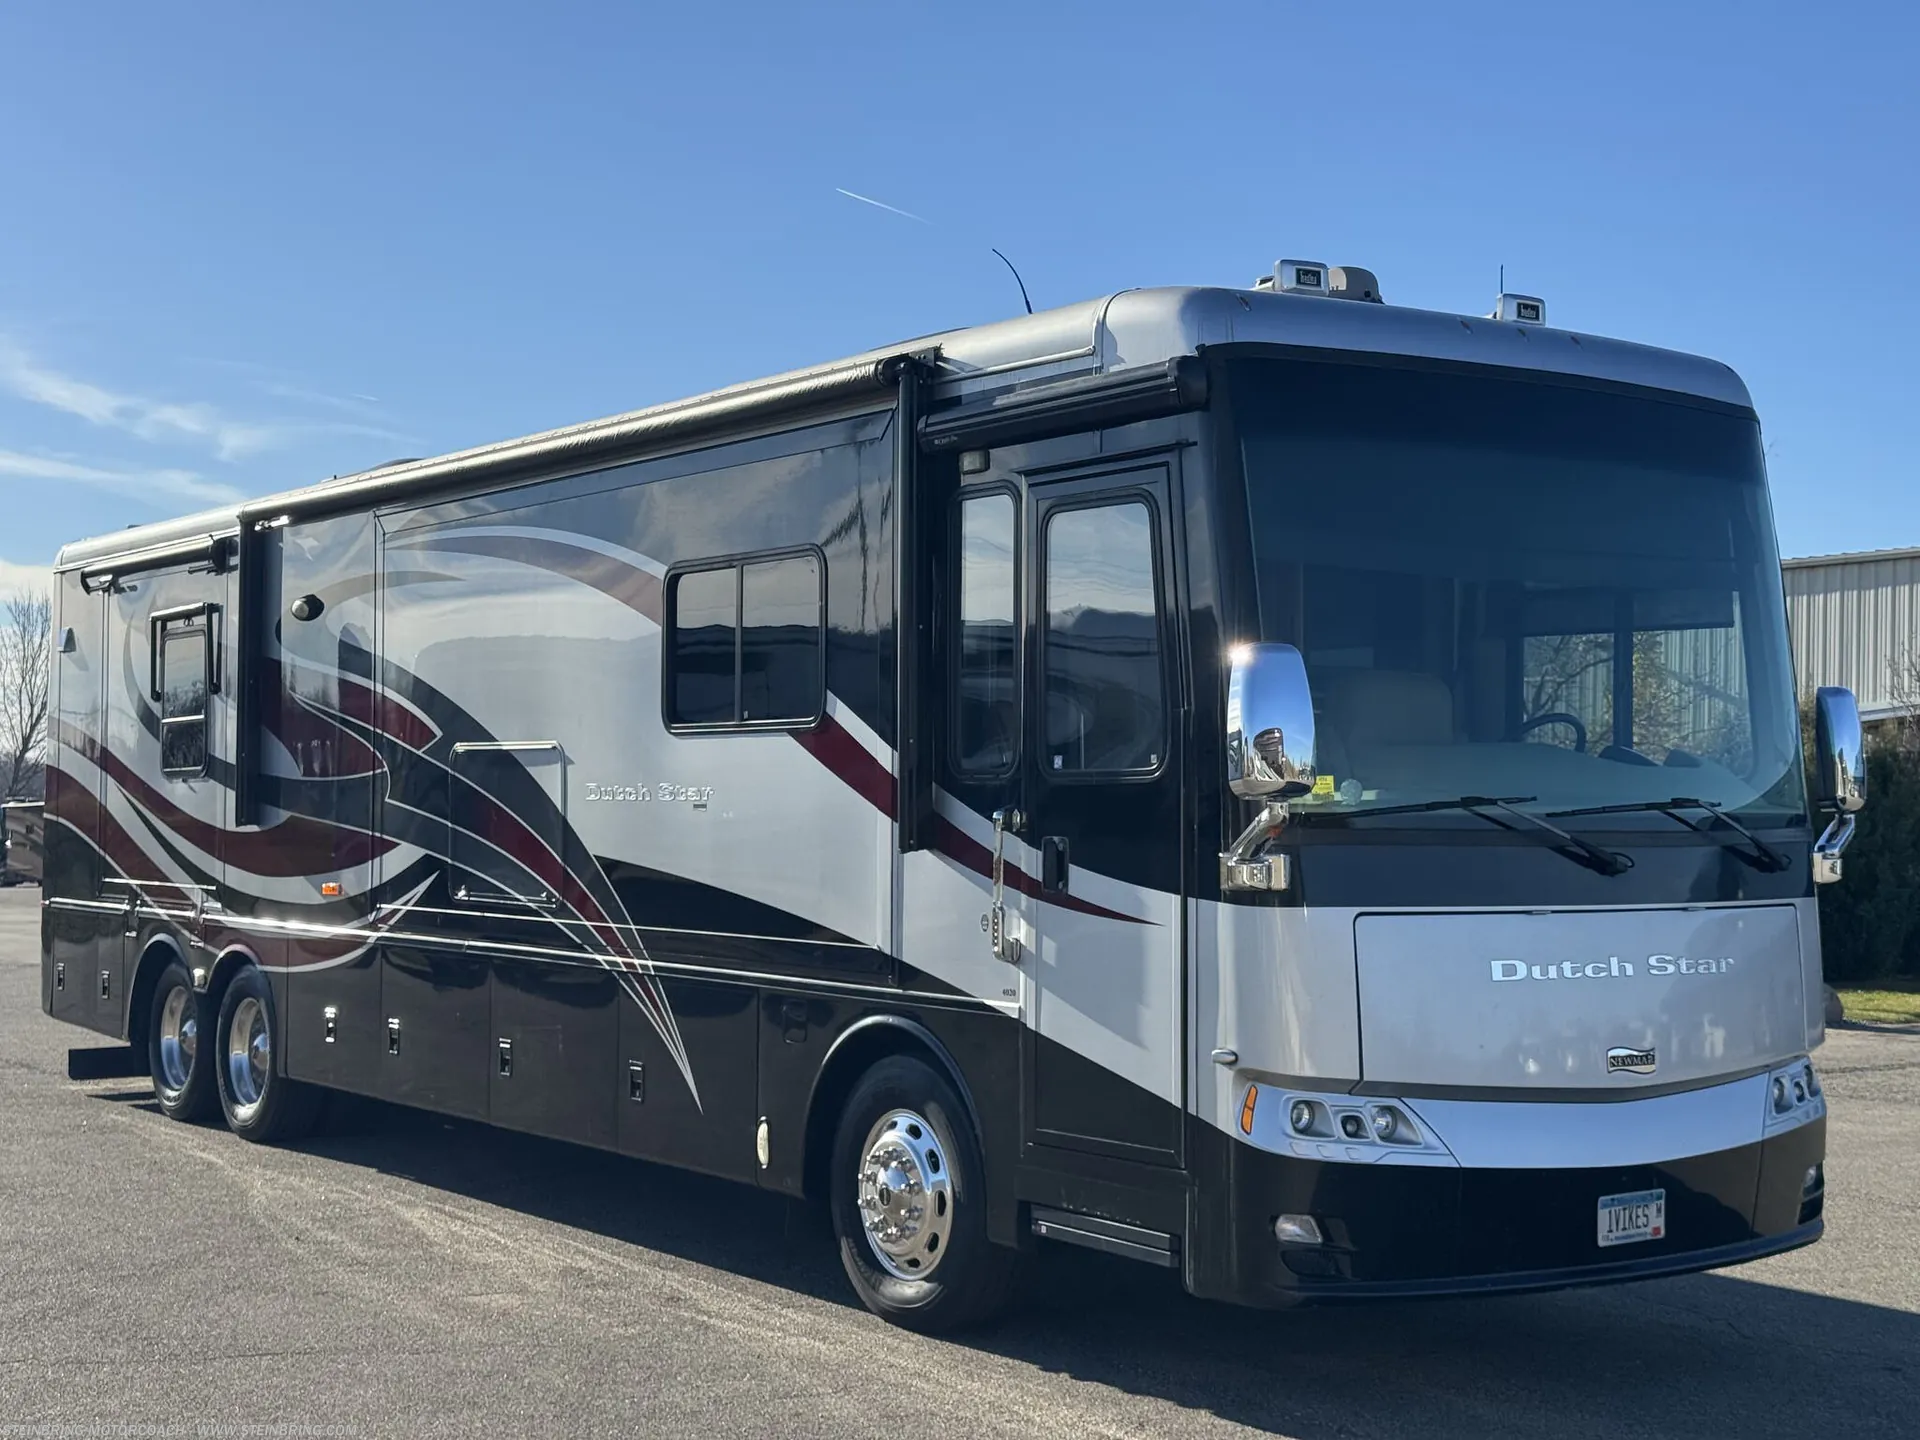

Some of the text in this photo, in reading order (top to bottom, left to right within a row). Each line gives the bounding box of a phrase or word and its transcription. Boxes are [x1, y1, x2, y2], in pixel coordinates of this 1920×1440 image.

[585, 782, 716, 801] Dutch Star
[1489, 954, 1735, 982] Dutch Star
